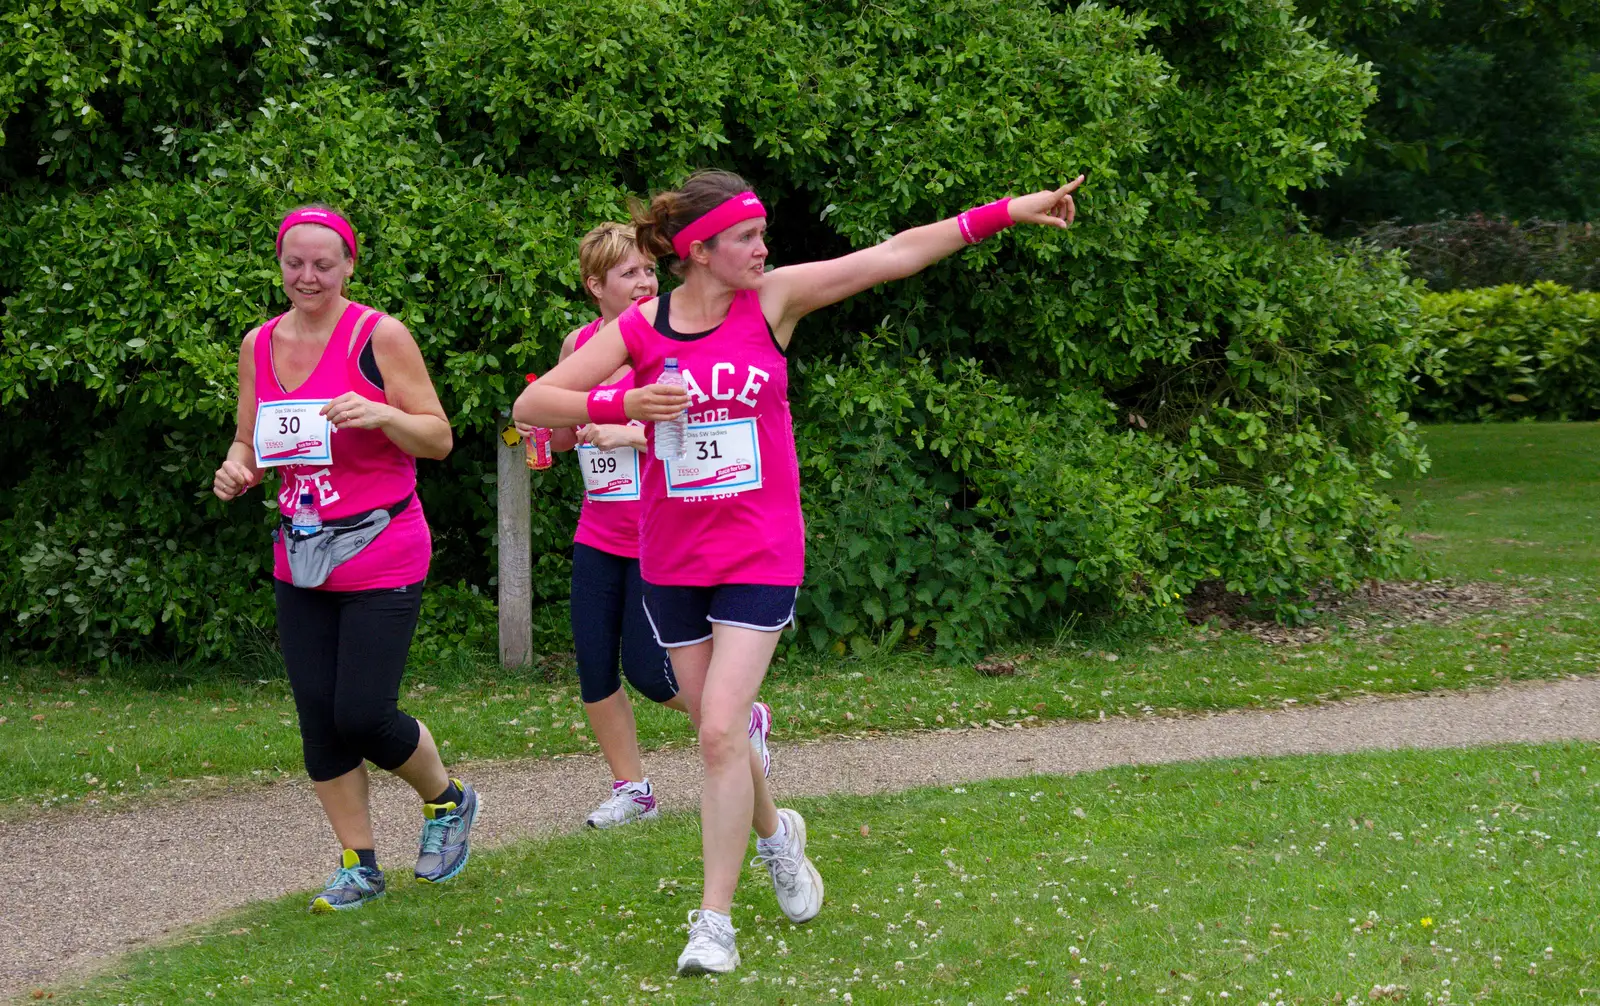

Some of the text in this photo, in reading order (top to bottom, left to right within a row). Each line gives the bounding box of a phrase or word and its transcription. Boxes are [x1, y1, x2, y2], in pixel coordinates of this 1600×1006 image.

[681, 361, 770, 409] ACE
[278, 416, 301, 435] 30
[695, 440, 723, 461] 31
[590, 457, 617, 474] 199
